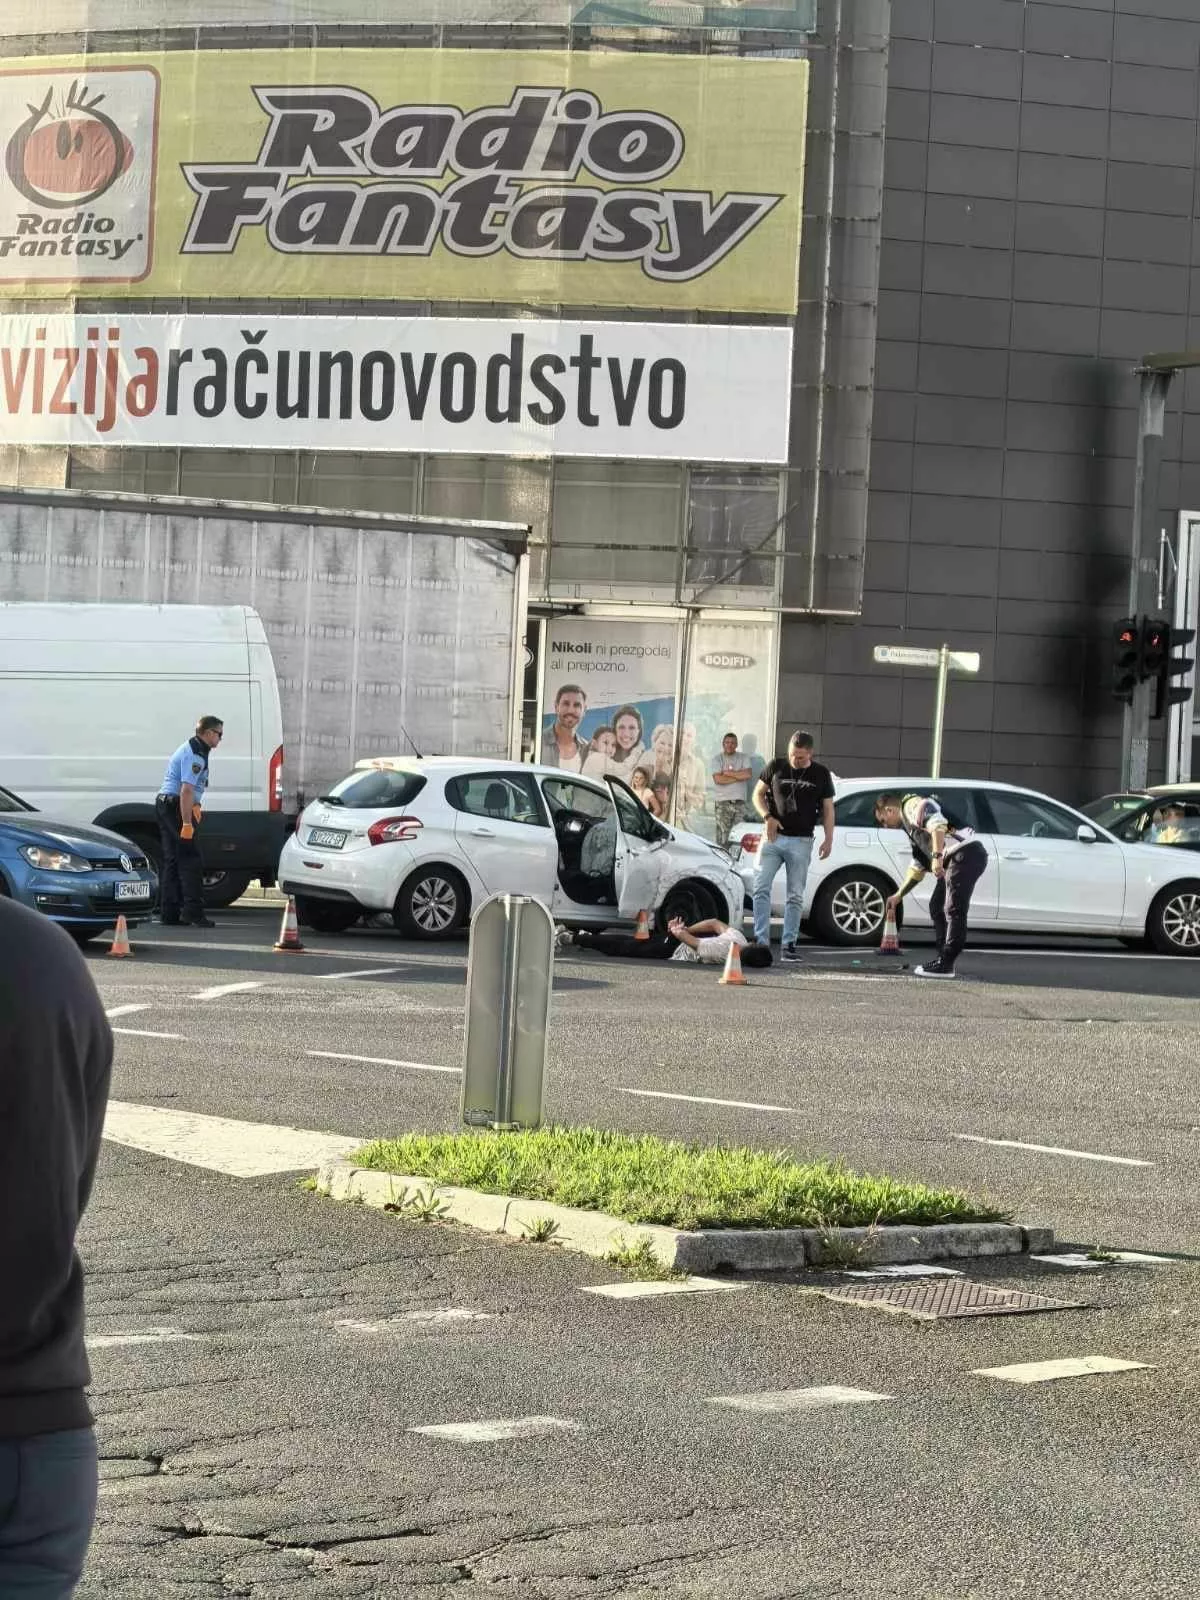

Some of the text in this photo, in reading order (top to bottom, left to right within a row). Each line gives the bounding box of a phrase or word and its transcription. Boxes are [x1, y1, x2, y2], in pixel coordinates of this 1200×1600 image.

[252, 86, 685, 182] Radio
[16, 212, 115, 235] Radio
[180, 162, 786, 282] Fantasy
[0, 234, 137, 261] Fantasy
[551, 641, 671, 659] Nikoli ni prezgodaj
[704, 654, 750, 667] BODIFIT
[551, 659, 629, 673] ali prepozno.
